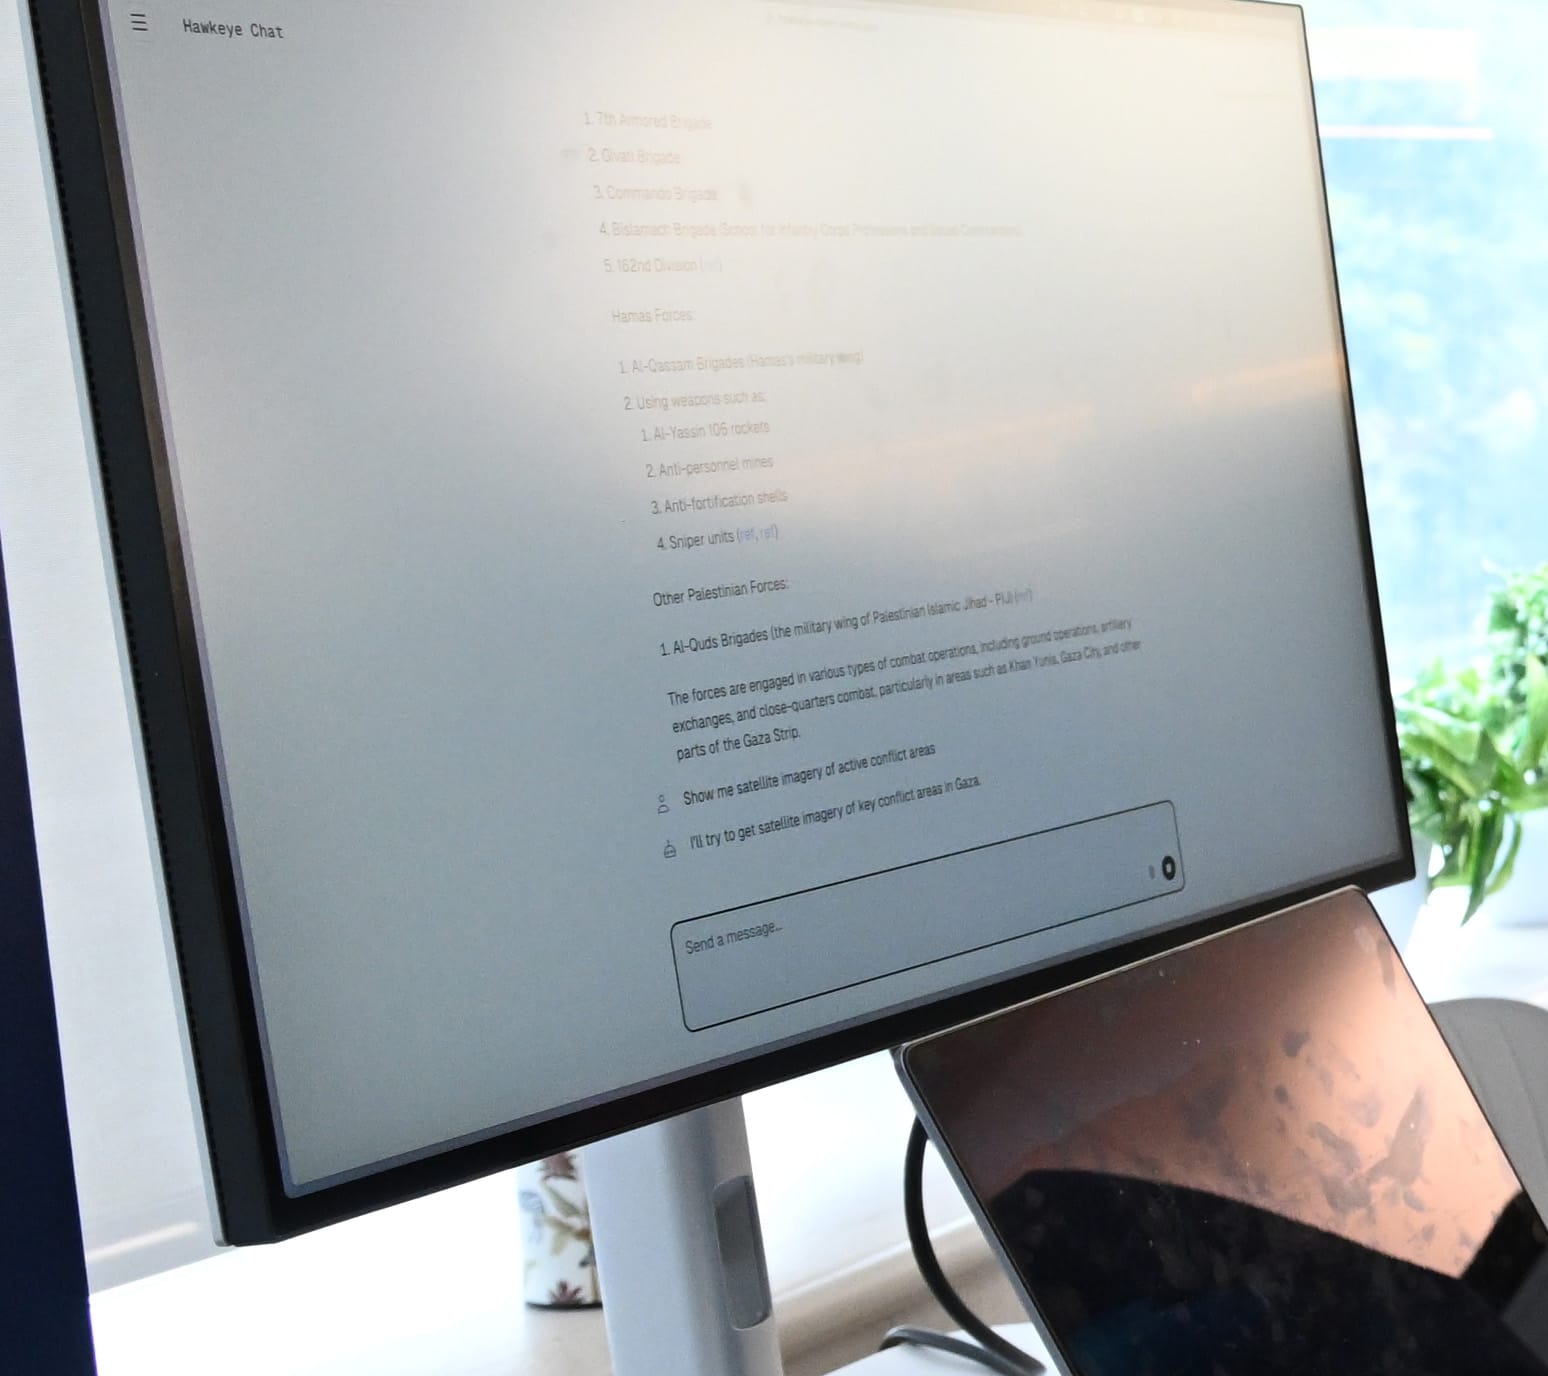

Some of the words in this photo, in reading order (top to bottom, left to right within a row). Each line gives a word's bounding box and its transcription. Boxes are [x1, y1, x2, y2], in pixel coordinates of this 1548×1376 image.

[182, 19, 243, 37] Hawkeye
[250, 23, 284, 39] Chat
[651, 500, 662, 515] 3.
[653, 592, 685, 607] Other
[687, 585, 748, 601] Palestinian
[750, 579, 789, 593] Forces:
[660, 643, 671, 657] 1.
[673, 638, 719, 653] Al-Quds
[720, 630, 769, 647] Brigades
[770, 626, 792, 640] (the
[794, 621, 832, 635] military
[833, 617, 859, 630] wing
[860, 612, 870, 626] of
[872, 607, 926, 623] Palestinian
[666, 691, 689, 705] The
[691, 686, 727, 701] forces
[729, 683, 747, 696] are
[749, 674, 795, 693] engaged
[797, 673, 807, 684] in
[808, 667, 846, 682] various
[847, 661, 876, 677] types
[877, 656, 887, 670] of
[889, 652, 926, 668] combat
[927, 645, 979, 662] operations,
[672, 713, 735, 733] exchanges,
[736, 706, 757, 722] and
[758, 695, 835, 717] close-quarters
[837, 687, 878, 703] combat,
[879, 678, 933, 696] particularly
[935, 675, 944, 685] in
[946, 670, 972, 684] areas
[973, 665, 995, 679] such
[676, 745, 707, 761] parts
[708, 739, 720, 754] of
[722, 738, 741, 751] the
[743, 733, 772, 748] Gaza
[773, 728, 801, 742] Strip.
[683, 790, 714, 805] Show
[717, 785, 734, 798] me
[736, 776, 779, 794] satellite
[781, 768, 823, 784] imagery
[825, 761, 835, 776] of
[838, 758, 869, 774] active
[870, 750, 907, 767] conflict
[909, 744, 936, 759] areas
[690, 835, 704, 849] I'll
[705, 834, 721, 847] try
[723, 830, 736, 842] to
[738, 825, 756, 842] get
[758, 816, 801, 834] satellite
[802, 807, 843, 823] imagery
[845, 801, 856, 815] of
[858, 800, 876, 812] key
[878, 790, 915, 808] conflict
[916, 784, 943, 799] areas
[945, 782, 954, 792] in
[954, 776, 981, 790] Gaza
[685, 936, 715, 955] Send
[716, 935, 725, 947] a
[726, 923, 783, 942] message...
